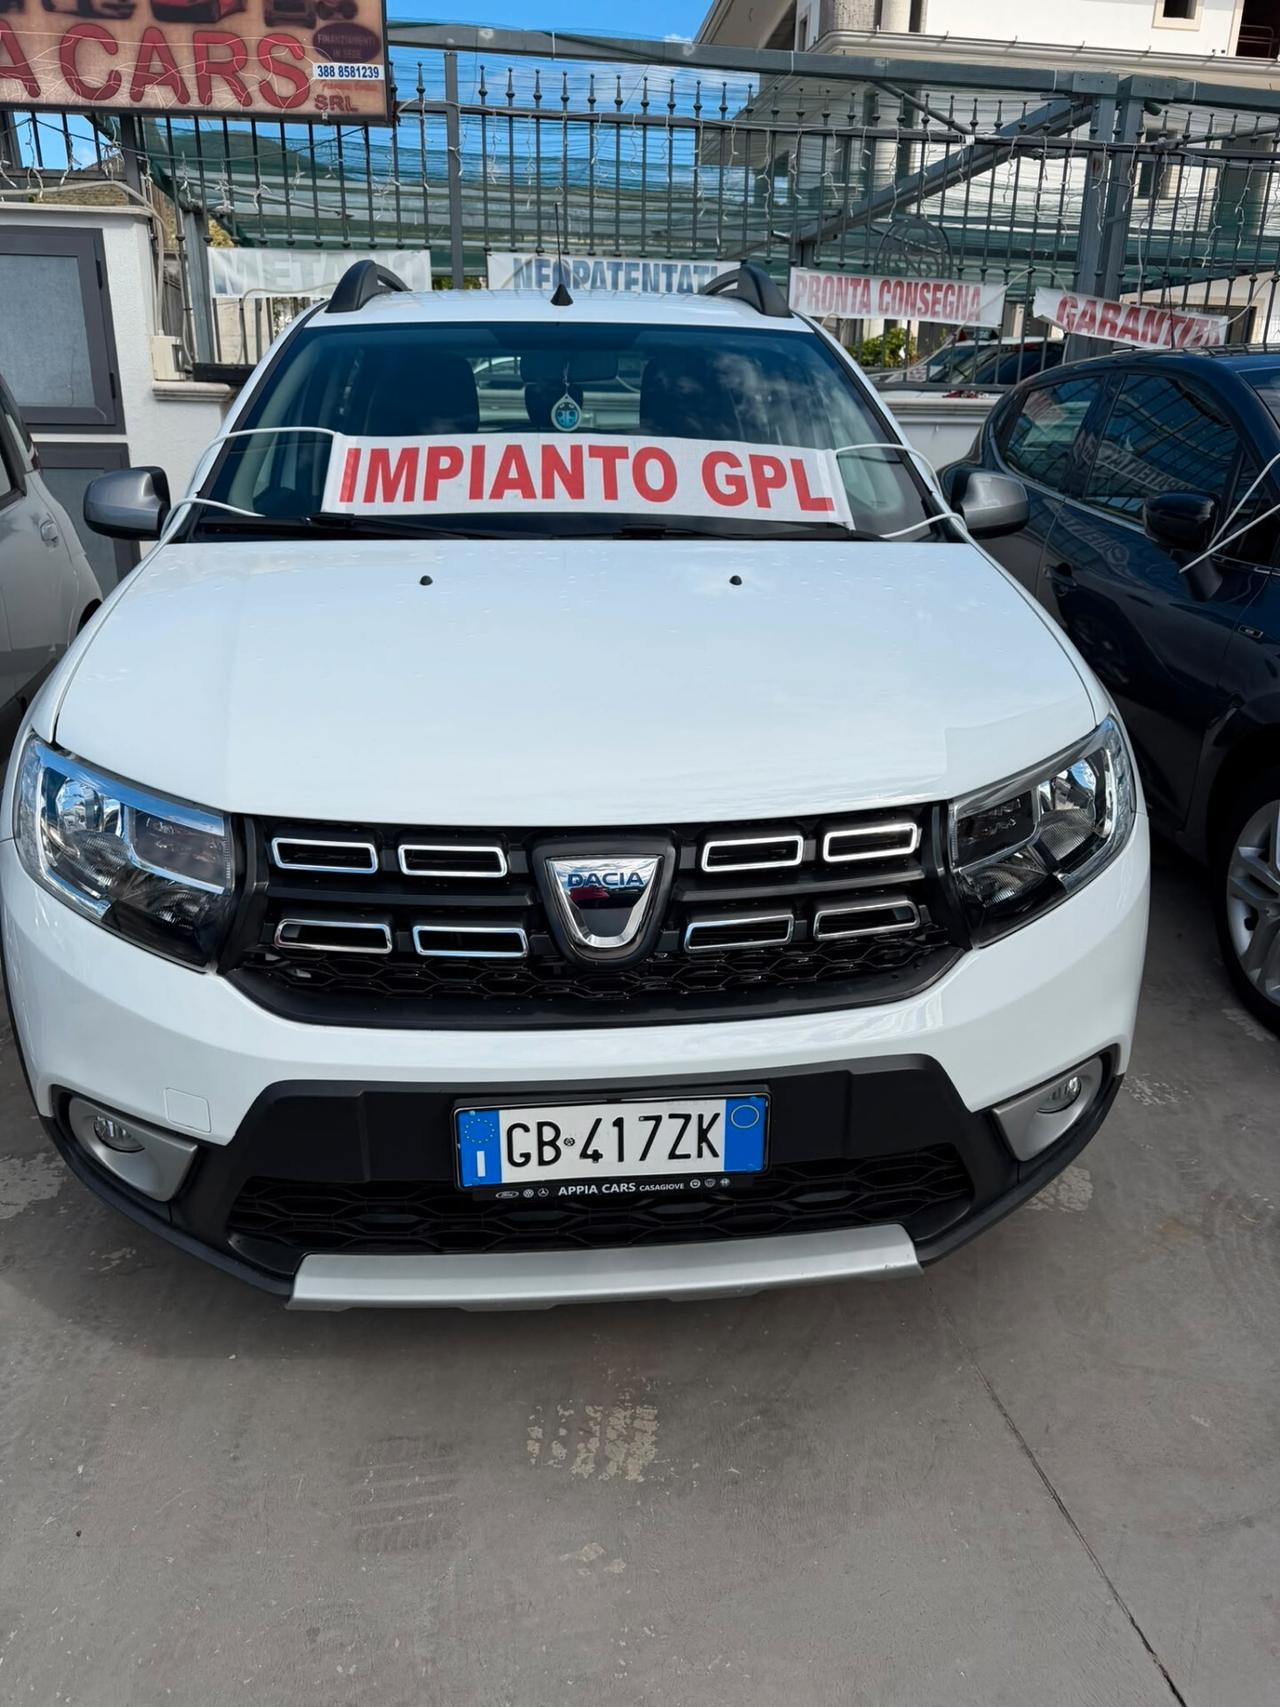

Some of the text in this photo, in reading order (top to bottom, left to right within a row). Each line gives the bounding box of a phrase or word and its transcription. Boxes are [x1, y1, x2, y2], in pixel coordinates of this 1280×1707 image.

[59, 23, 310, 109] CARS
[317, 65, 379, 78] 388 8581239
[314, 94, 359, 112] SRL
[794, 274, 981, 321] PRONTA CONSEGNA
[339, 444, 835, 512] IMPIANTO GPL
[567, 872, 644, 888] DACIA
[558, 1182, 685, 1196] APPIA CARS CASAGIOVE
